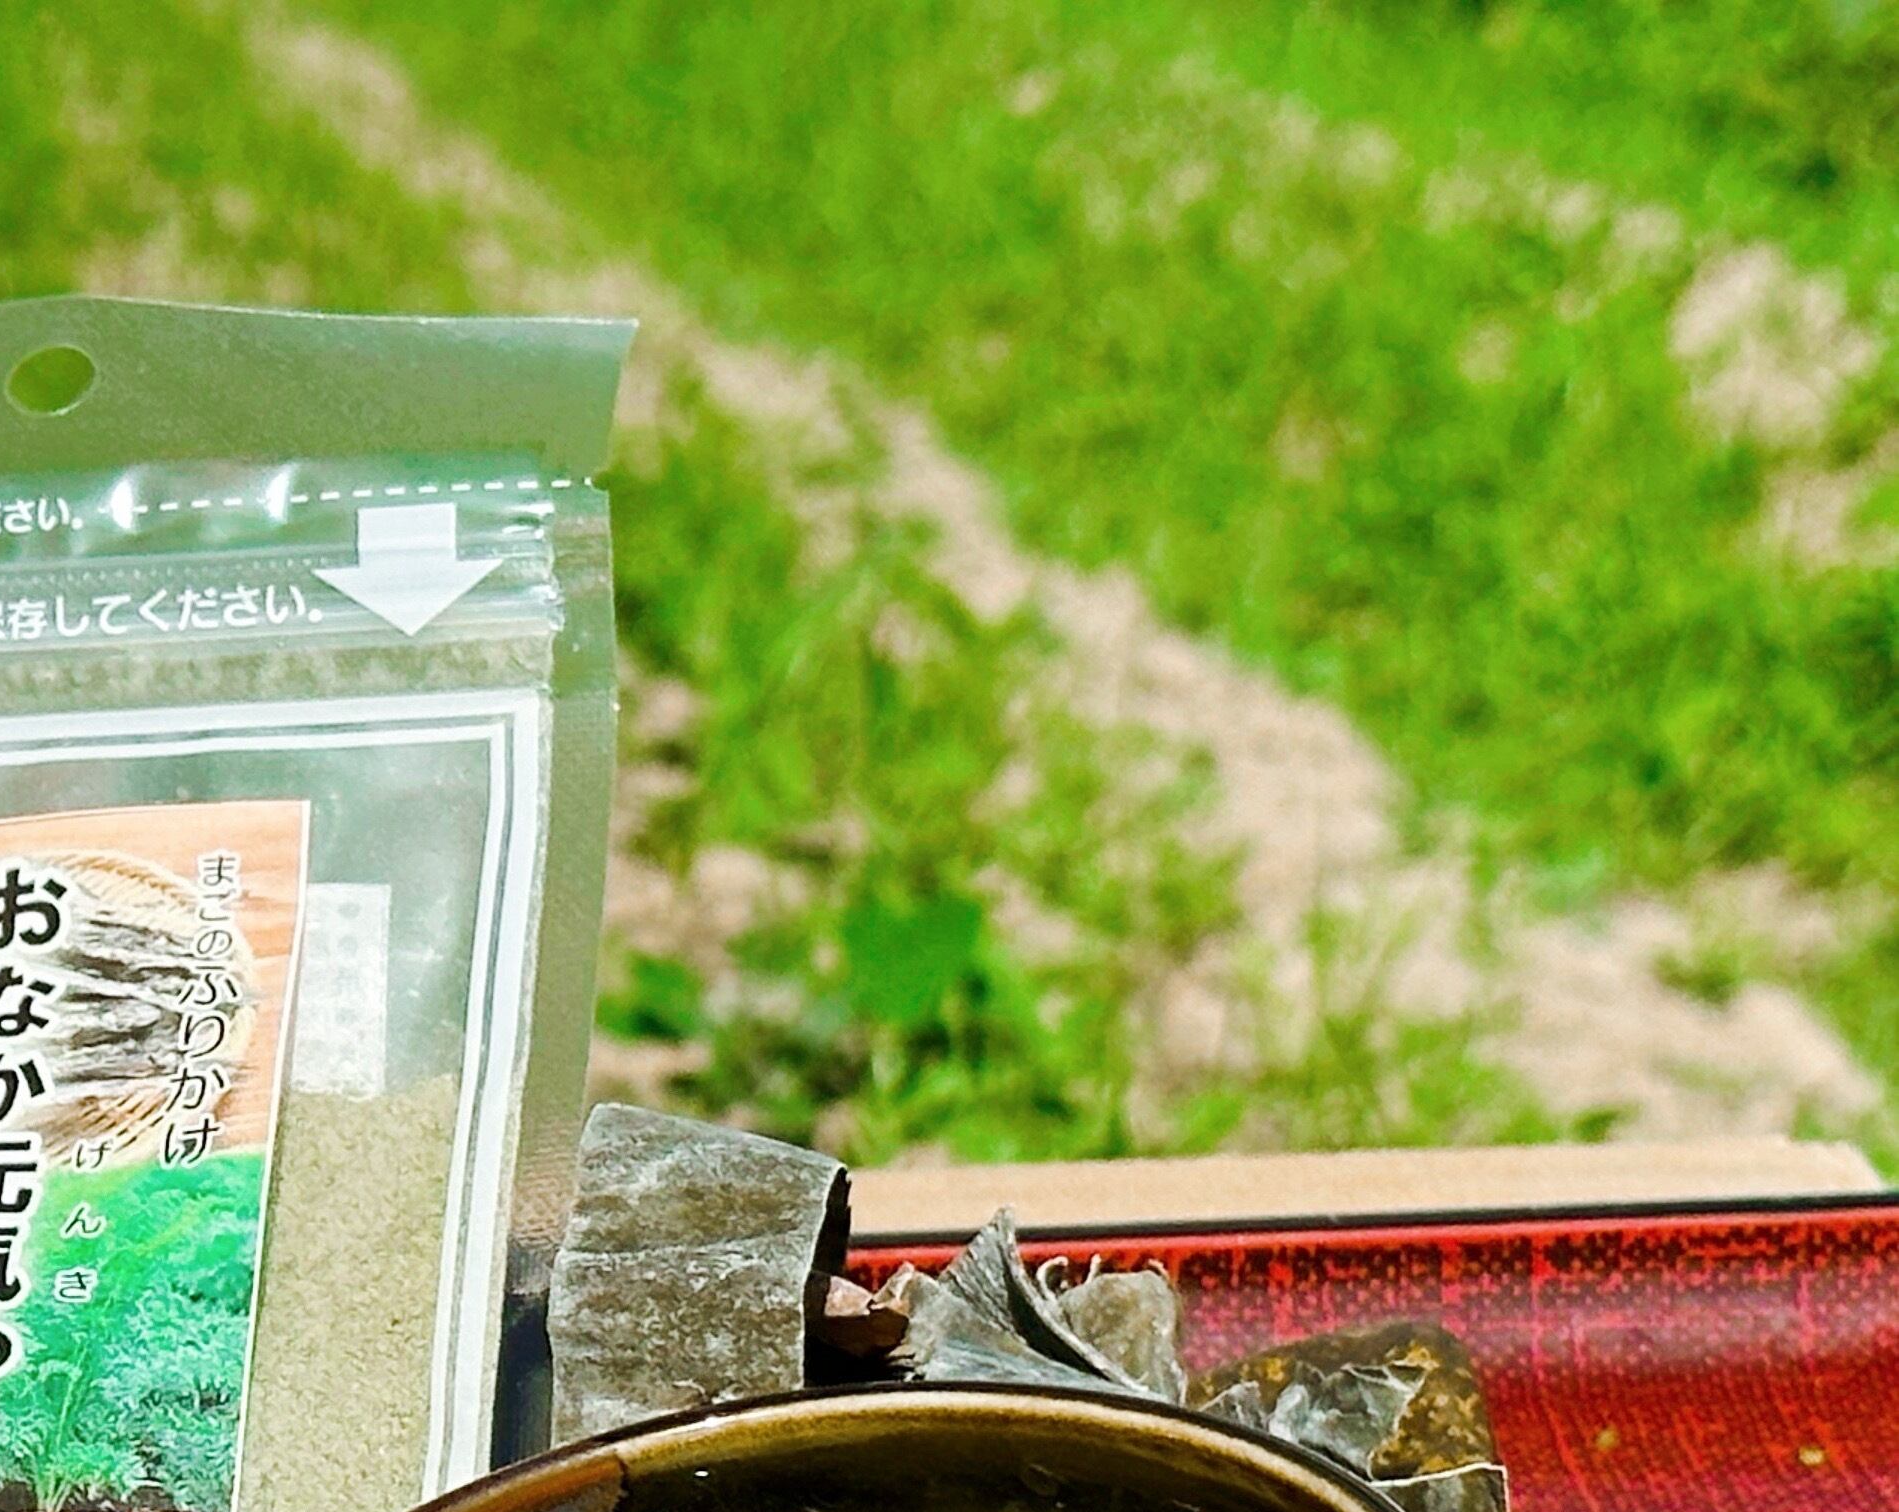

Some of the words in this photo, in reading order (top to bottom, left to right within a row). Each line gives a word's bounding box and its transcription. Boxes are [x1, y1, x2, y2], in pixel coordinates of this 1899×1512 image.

[163, 855, 238, 1164] まごのふりかけ
[59, 1138, 113, 1299] げんき
